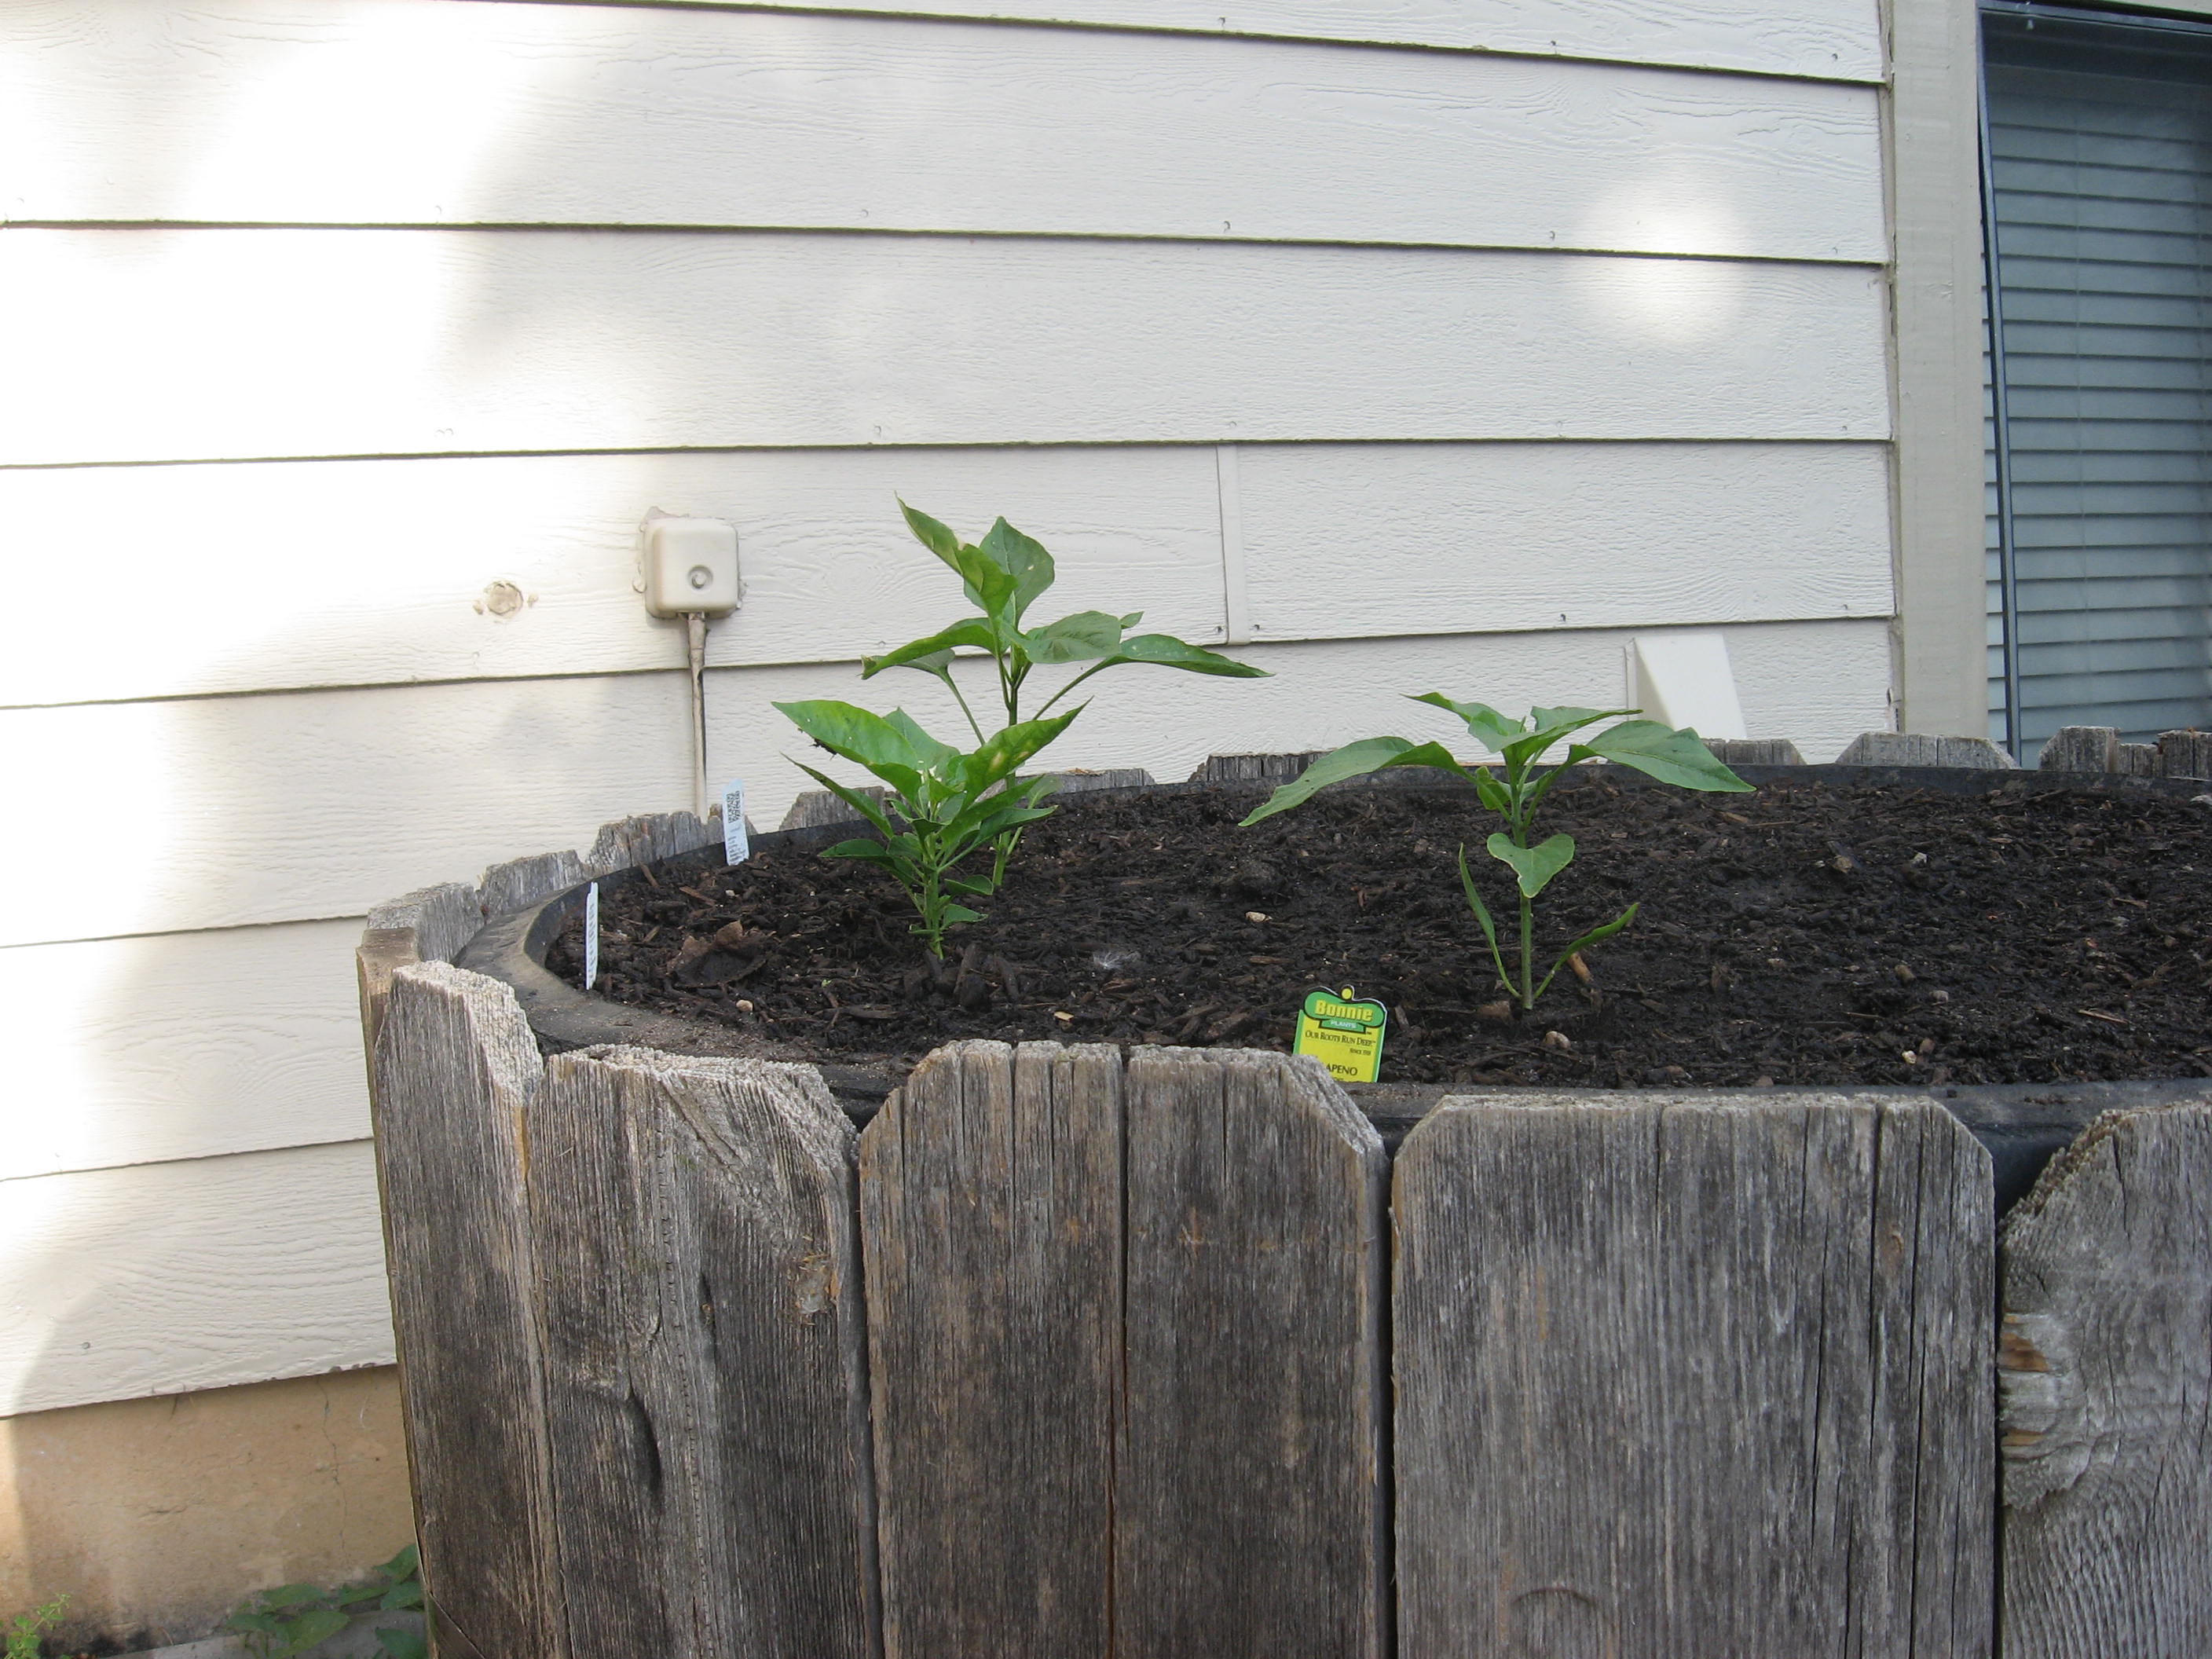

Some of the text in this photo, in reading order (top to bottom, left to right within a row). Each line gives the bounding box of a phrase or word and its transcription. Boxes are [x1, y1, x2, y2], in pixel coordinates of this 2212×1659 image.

[1315, 999, 1372, 1021] Bonnie
[1330, 1020, 1357, 1028] PLANTS
[1326, 1063, 1358, 1076] APENO
